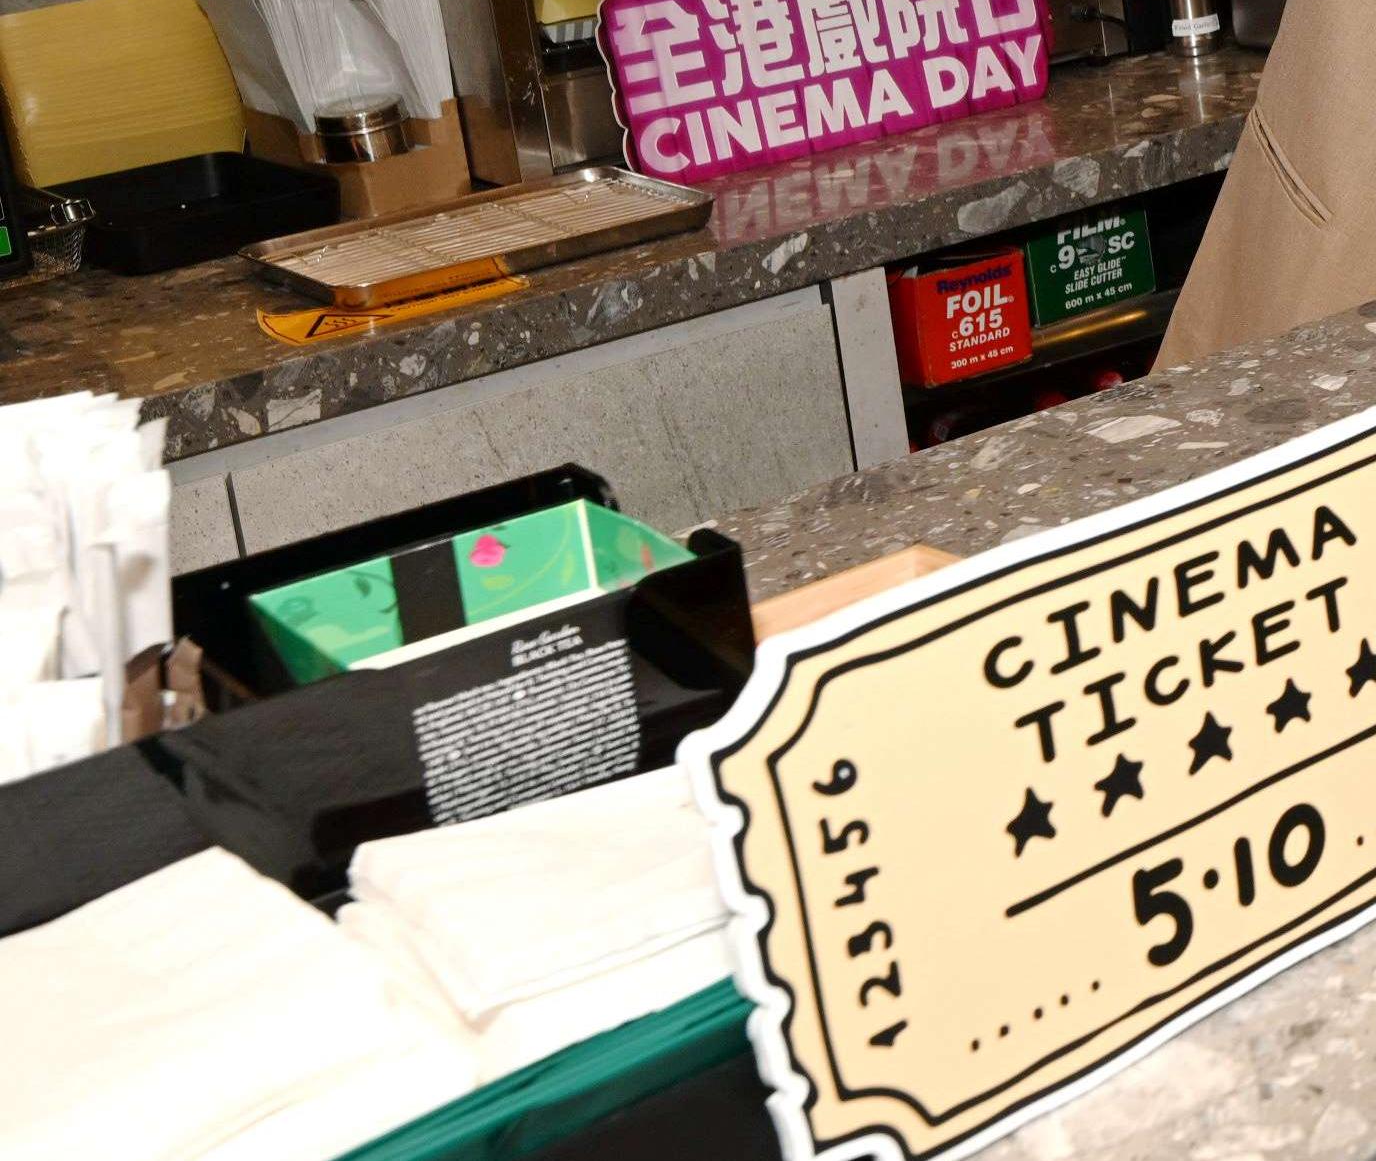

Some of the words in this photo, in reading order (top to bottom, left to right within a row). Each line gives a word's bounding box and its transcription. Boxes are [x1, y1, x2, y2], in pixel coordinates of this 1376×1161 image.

[640, 70, 915, 174] CINEMA
[923, 35, 1042, 109] DAY
[936, 262, 1013, 294] Reynolds
[1065, 280, 1088, 295] SLIDE
[1090, 269, 1124, 288] CUTTER
[1074, 266, 1096, 281] EASY
[1065, 298, 1083, 310] 600
[1085, 296, 1094, 306] m
[1119, 282, 1133, 294] cm
[959, 308, 1003, 337] 615
[949, 326, 1011, 353] STANDARD
[969, 356, 979, 366] m
[988, 349, 999, 360] 45
[1000, 345, 1014, 356] cm
[983, 505, 1358, 689] CINEMA
[1015, 577, 1350, 763] TICKET
[812, 757, 912, 1047] 123456
